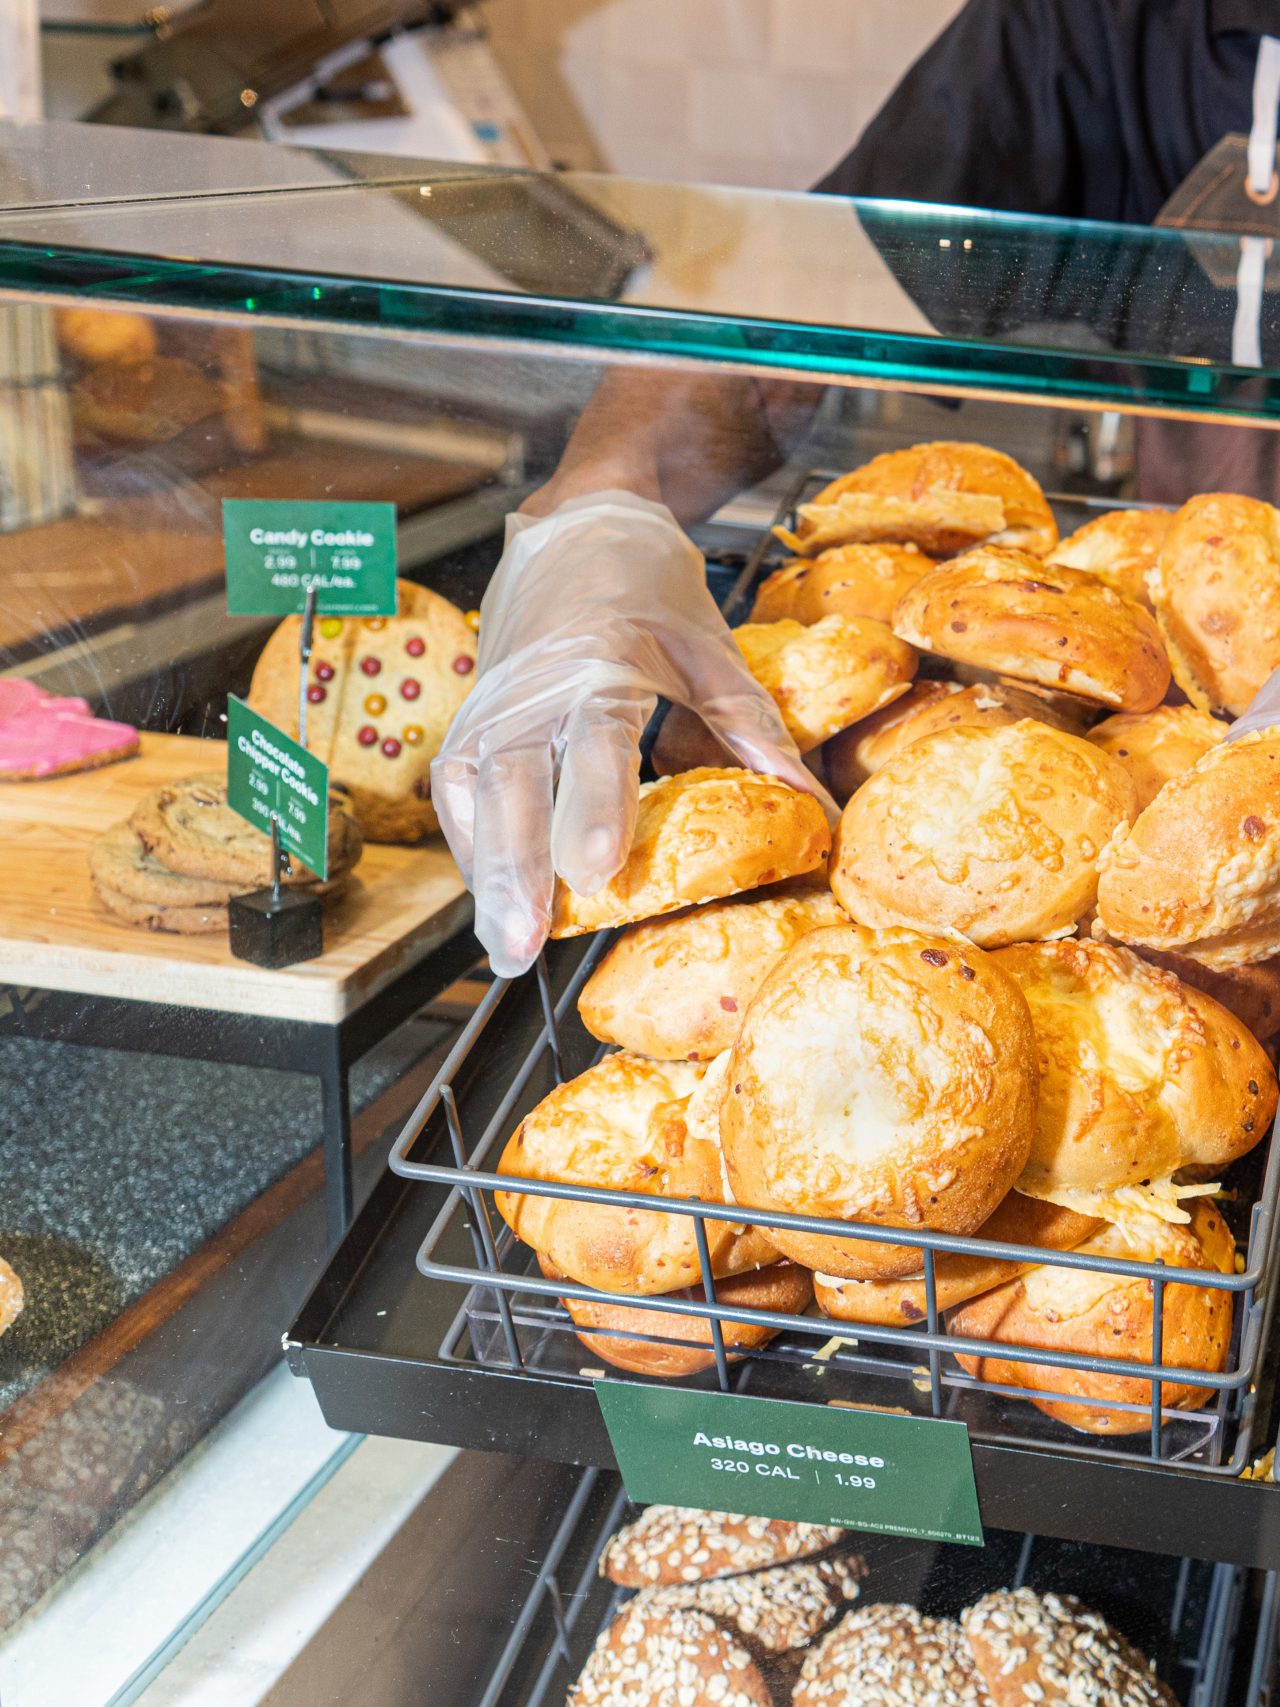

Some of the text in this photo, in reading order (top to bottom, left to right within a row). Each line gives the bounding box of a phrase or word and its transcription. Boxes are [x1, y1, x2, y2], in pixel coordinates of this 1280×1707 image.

[250, 528, 375, 549] Candy Cookie
[264, 554, 362, 571] 2.99 7.99
[238, 735, 319, 806] Chipper Cookie
[252, 729, 306, 780] Chocolate
[249, 773, 269, 796] 2.99
[288, 801, 306, 824] 7.99
[693, 1432, 885, 1469] Asiago Cheese
[710, 1458, 876, 1489] 320 CAL 1.99
